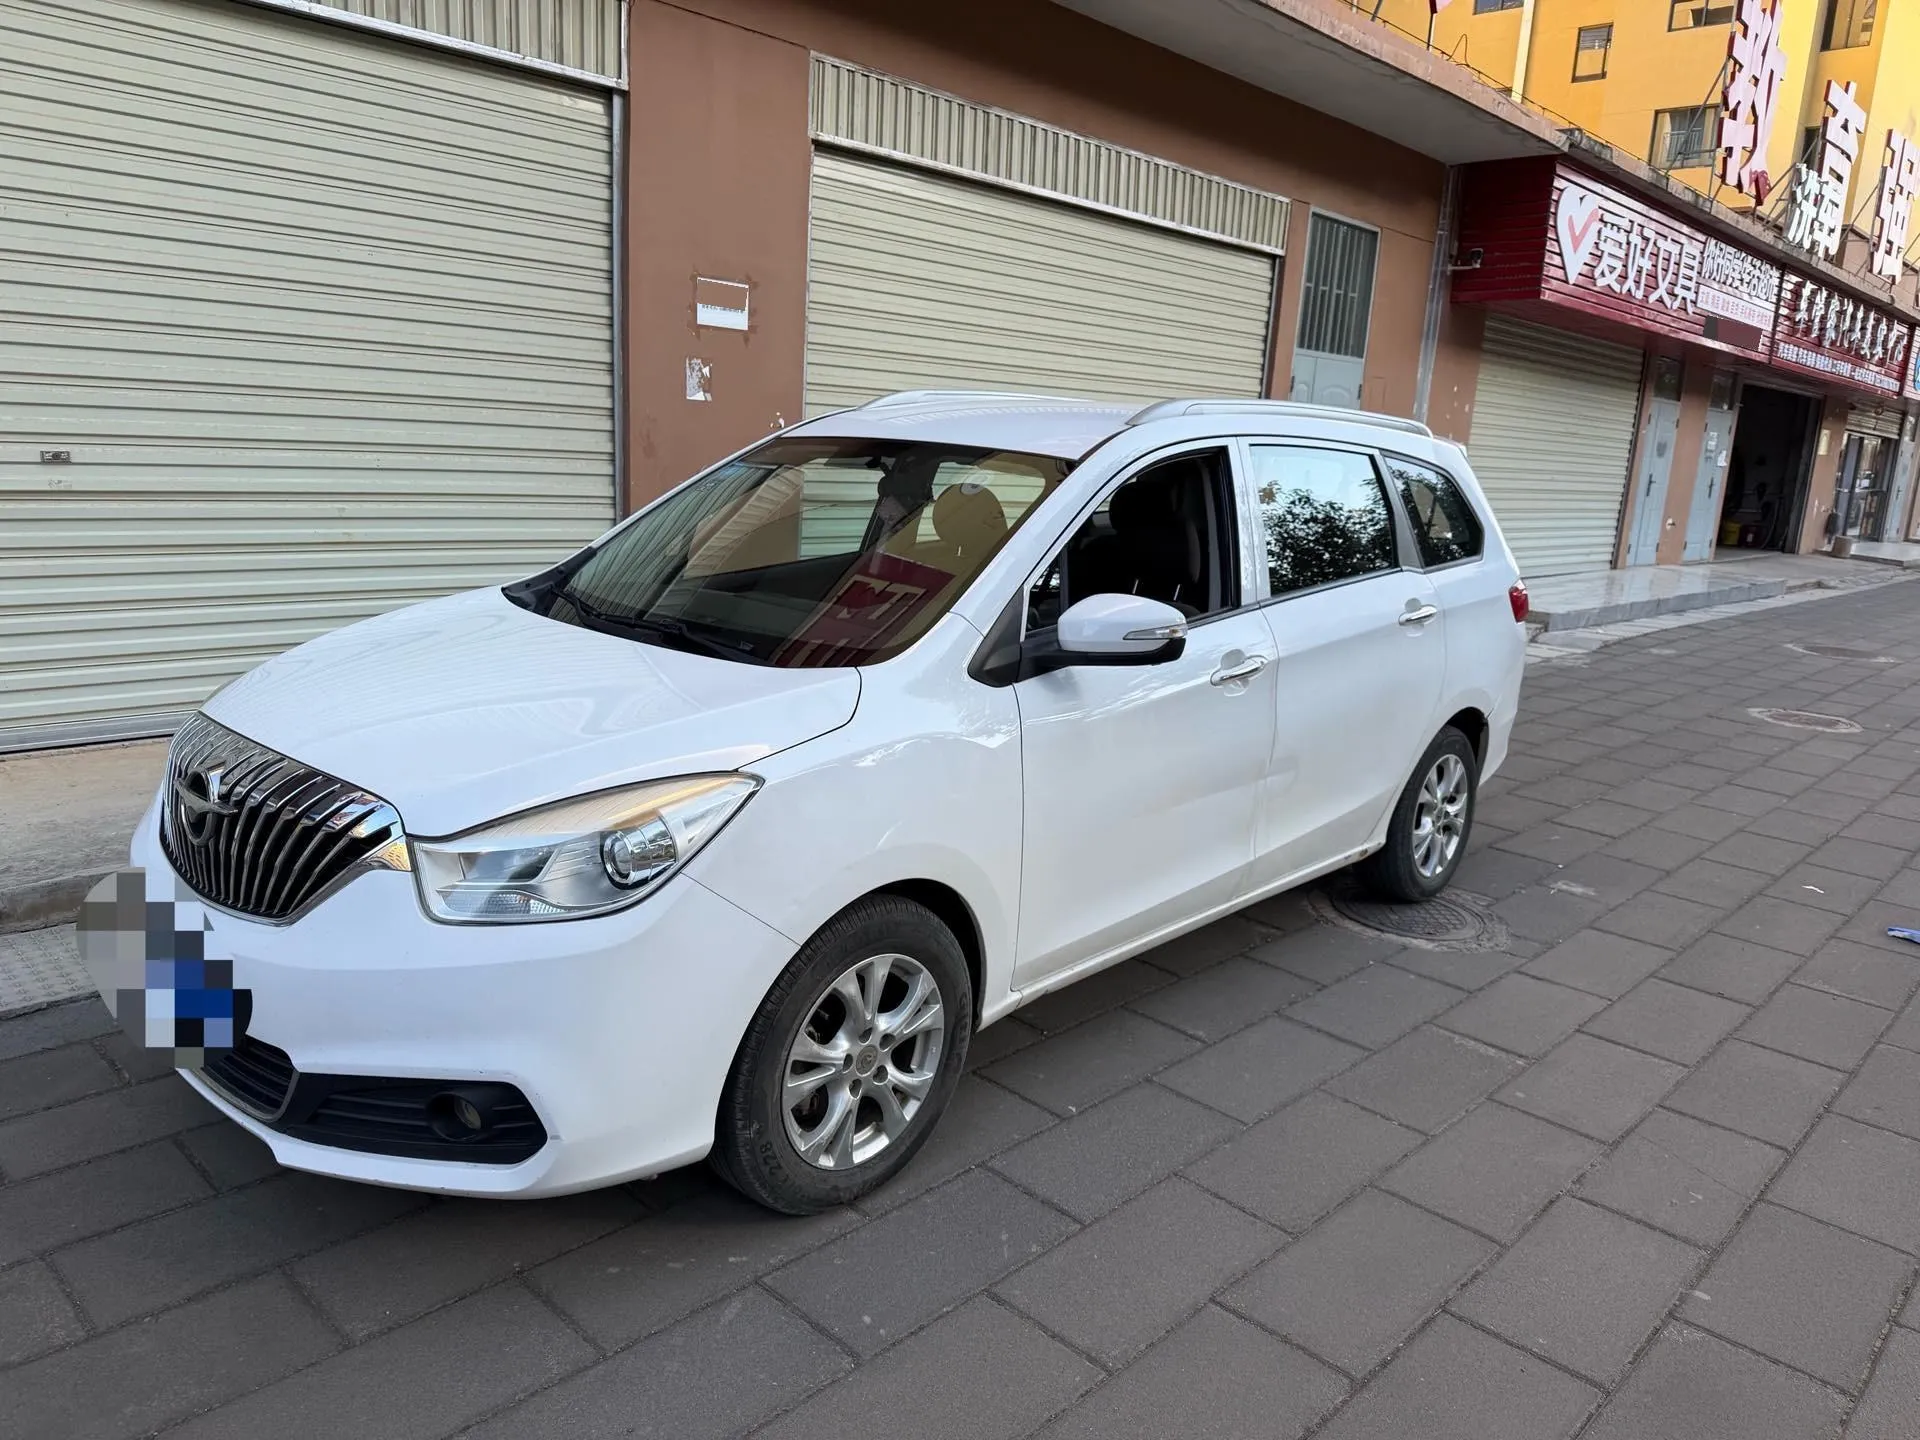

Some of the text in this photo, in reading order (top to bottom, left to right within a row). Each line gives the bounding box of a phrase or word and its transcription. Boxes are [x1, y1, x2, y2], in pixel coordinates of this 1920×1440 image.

[1787, 163, 1842, 257] 洗车
[1594, 213, 1701, 315] 爱好文具
